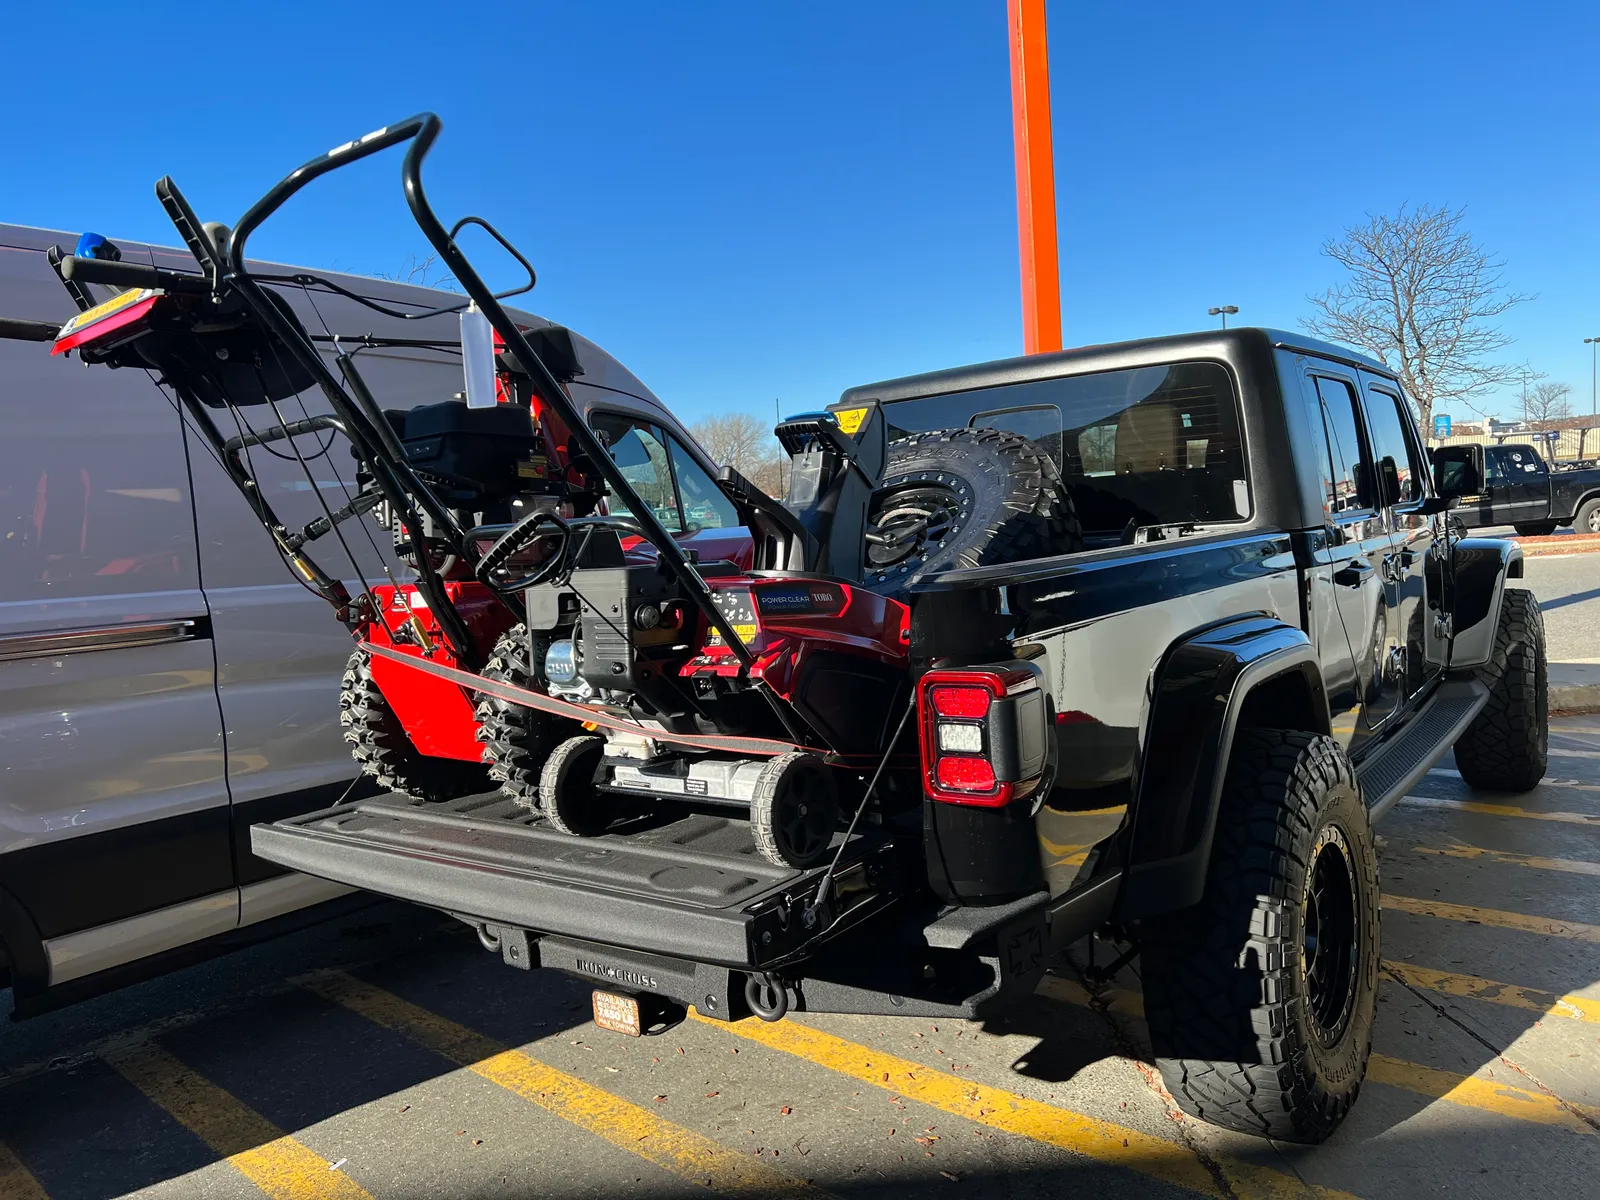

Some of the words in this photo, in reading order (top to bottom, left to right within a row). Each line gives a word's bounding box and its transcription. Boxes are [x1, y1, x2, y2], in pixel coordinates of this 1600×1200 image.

[761, 596, 787, 604] POWER
[788, 595, 810, 603] CLEAR
[811, 592, 833, 602] TORO
[576, 959, 607, 976] IRON
[616, 969, 657, 989] CROSS
[596, 992, 634, 1008] AVAILABLE
